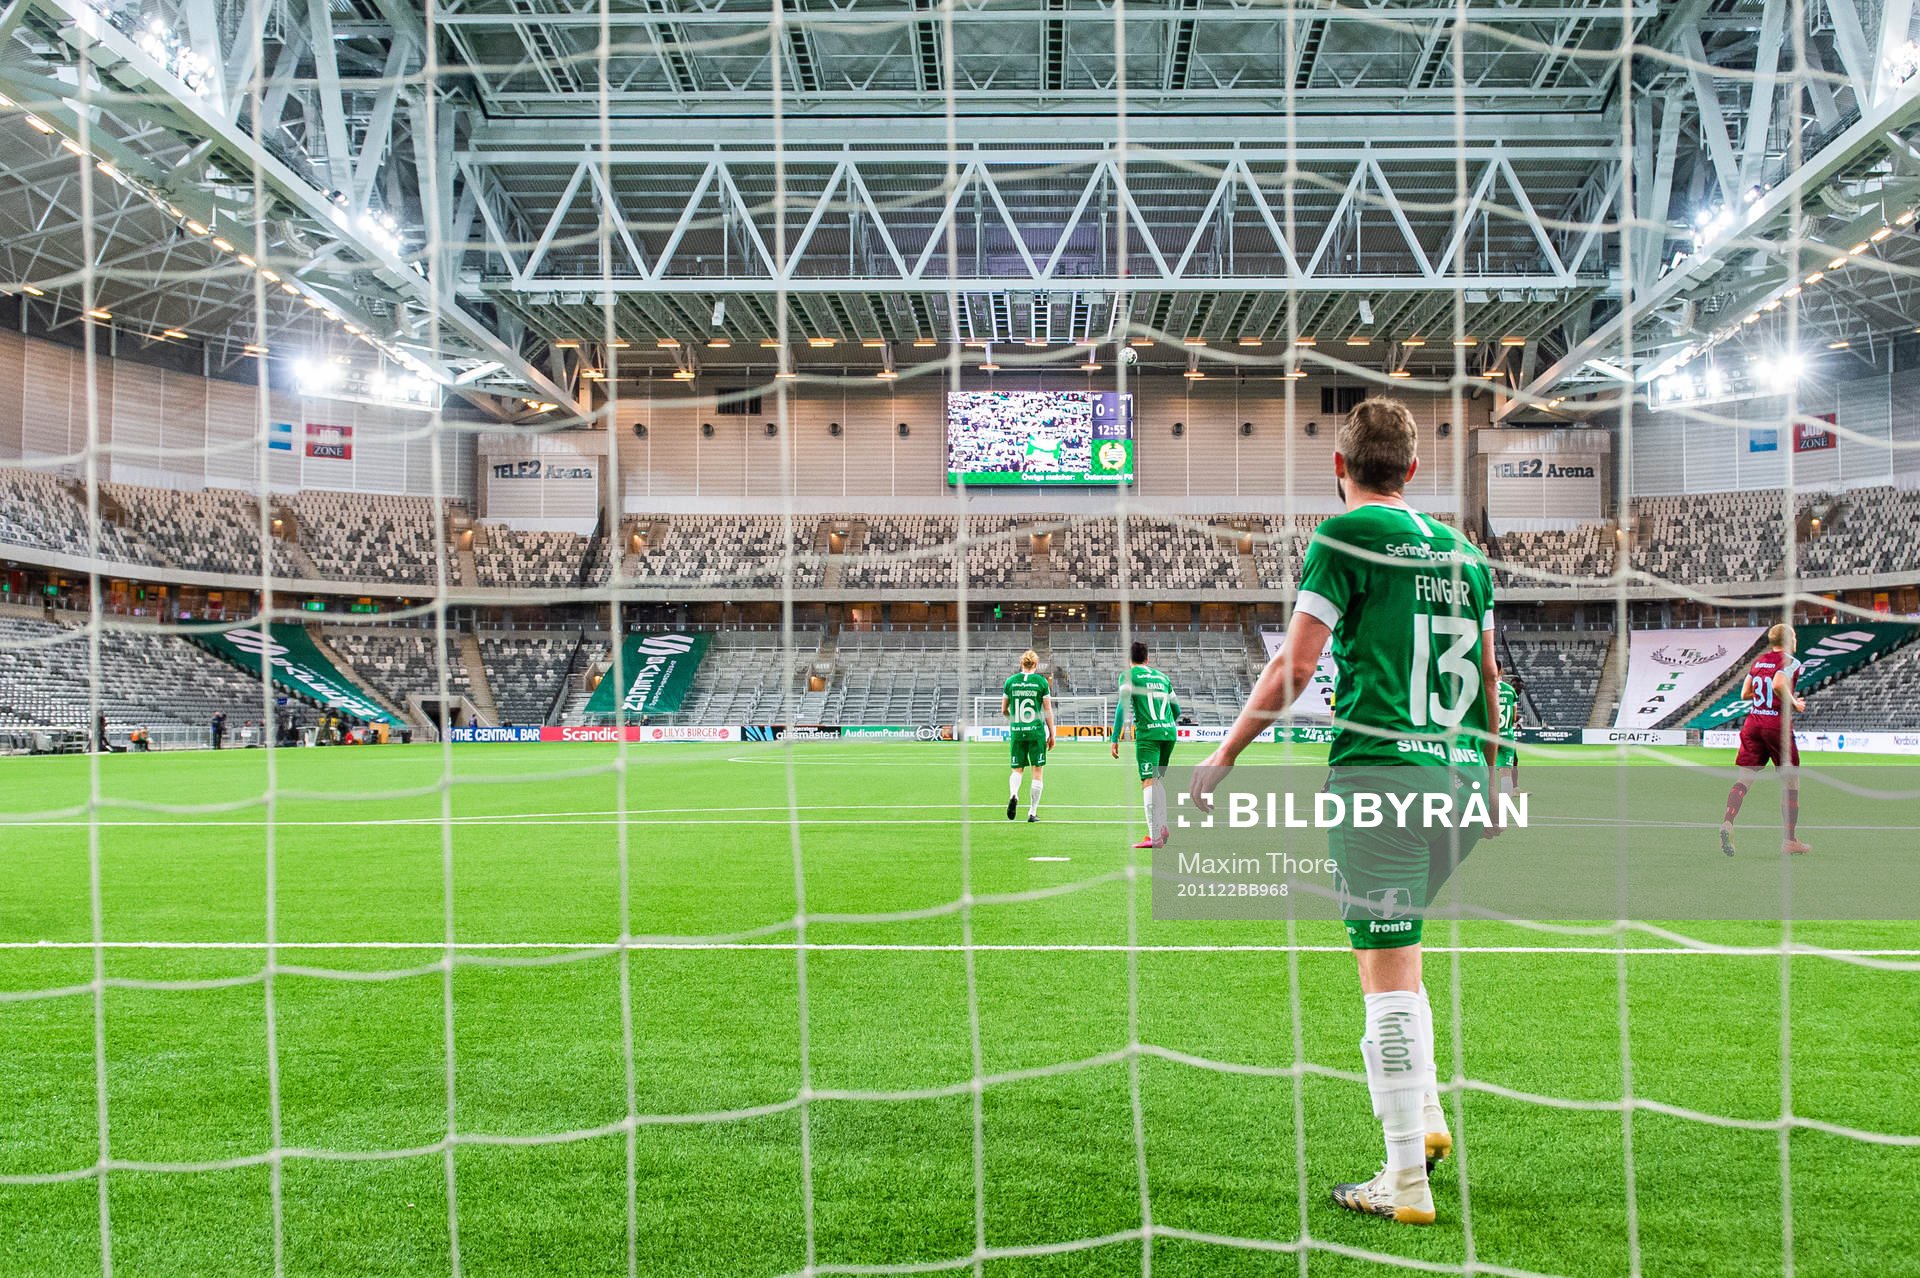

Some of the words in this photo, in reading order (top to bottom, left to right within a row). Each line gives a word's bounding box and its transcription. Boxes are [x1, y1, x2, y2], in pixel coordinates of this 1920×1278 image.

[1096, 404, 1105, 416] 0
[1120, 404, 1126, 416] 1
[1098, 425, 1126, 435] 12:55
[1801, 438, 1828, 449] ZONE
[314, 445, 344, 456] ZONE
[493, 460, 542, 479] TELE2
[545, 464, 592, 479] Arena
[1494, 459, 1543, 478] TELE2
[1546, 463, 1594, 478] Arena
[1415, 575, 1470, 607] FENGER
[1410, 613, 1480, 728] 13
[1752, 676, 1773, 709] 31
[1014, 698, 1036, 723] 16
[1147, 691, 1168, 721] 17
[454, 728, 473, 741] THE
[475, 728, 518, 741] CENTRAL
[520, 728, 540, 741] BAR
[562, 727, 619, 741] Scandic
[687, 728, 717, 738] BURGER
[844, 728, 914, 738] AudicomPendax
[1196, 729, 1221, 737] Stena
[1609, 732, 1650, 742] CRAFT
[1450, 747, 1479, 763] INE
[1369, 920, 1412, 933] fronta
